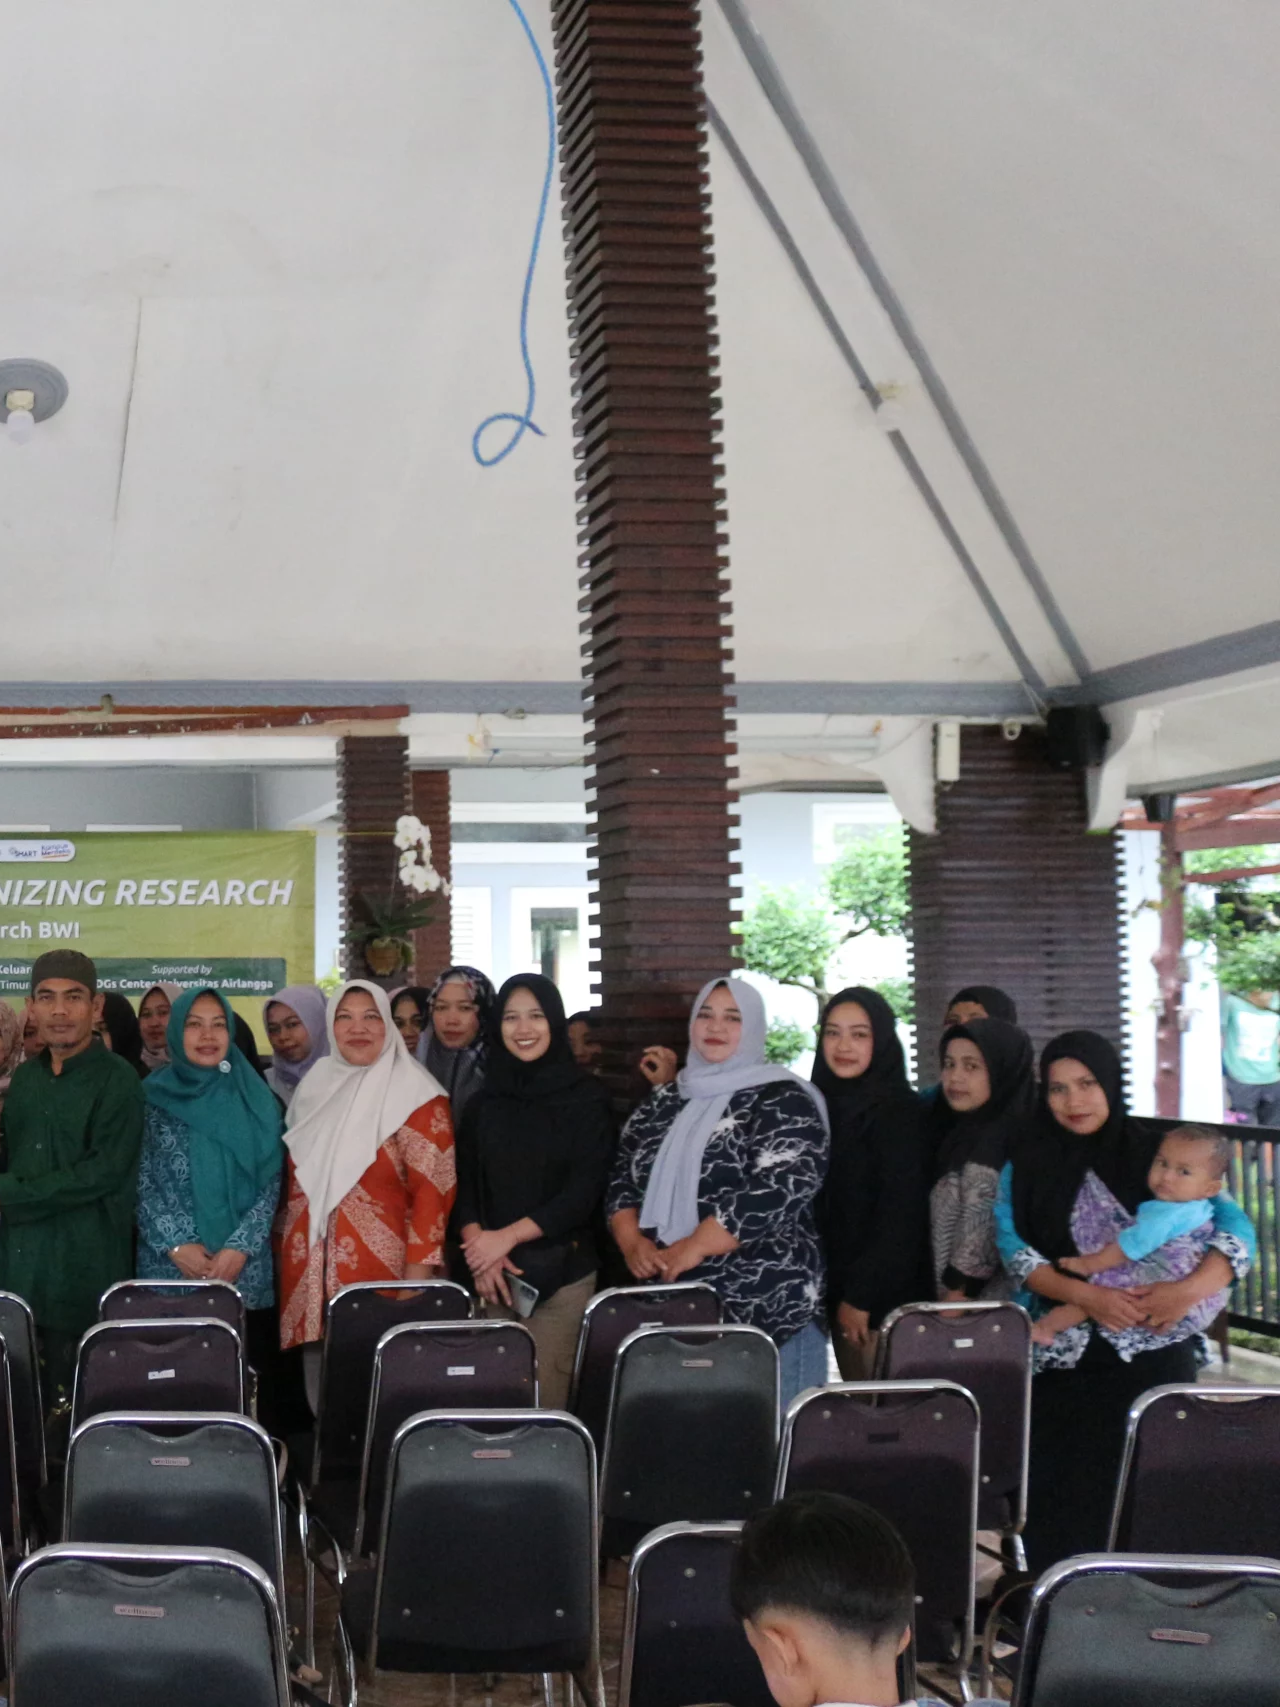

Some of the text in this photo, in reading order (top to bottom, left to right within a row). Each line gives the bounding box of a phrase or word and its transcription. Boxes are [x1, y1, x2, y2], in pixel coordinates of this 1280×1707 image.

[114, 879, 295, 906] RESEARCH
[38, 921, 80, 939] BWI
[151, 964, 213, 976] Supported by
[0, 980, 30, 990] Timur
[95, 979, 117, 989] DGs
[221, 978, 273, 990] Airlangga
